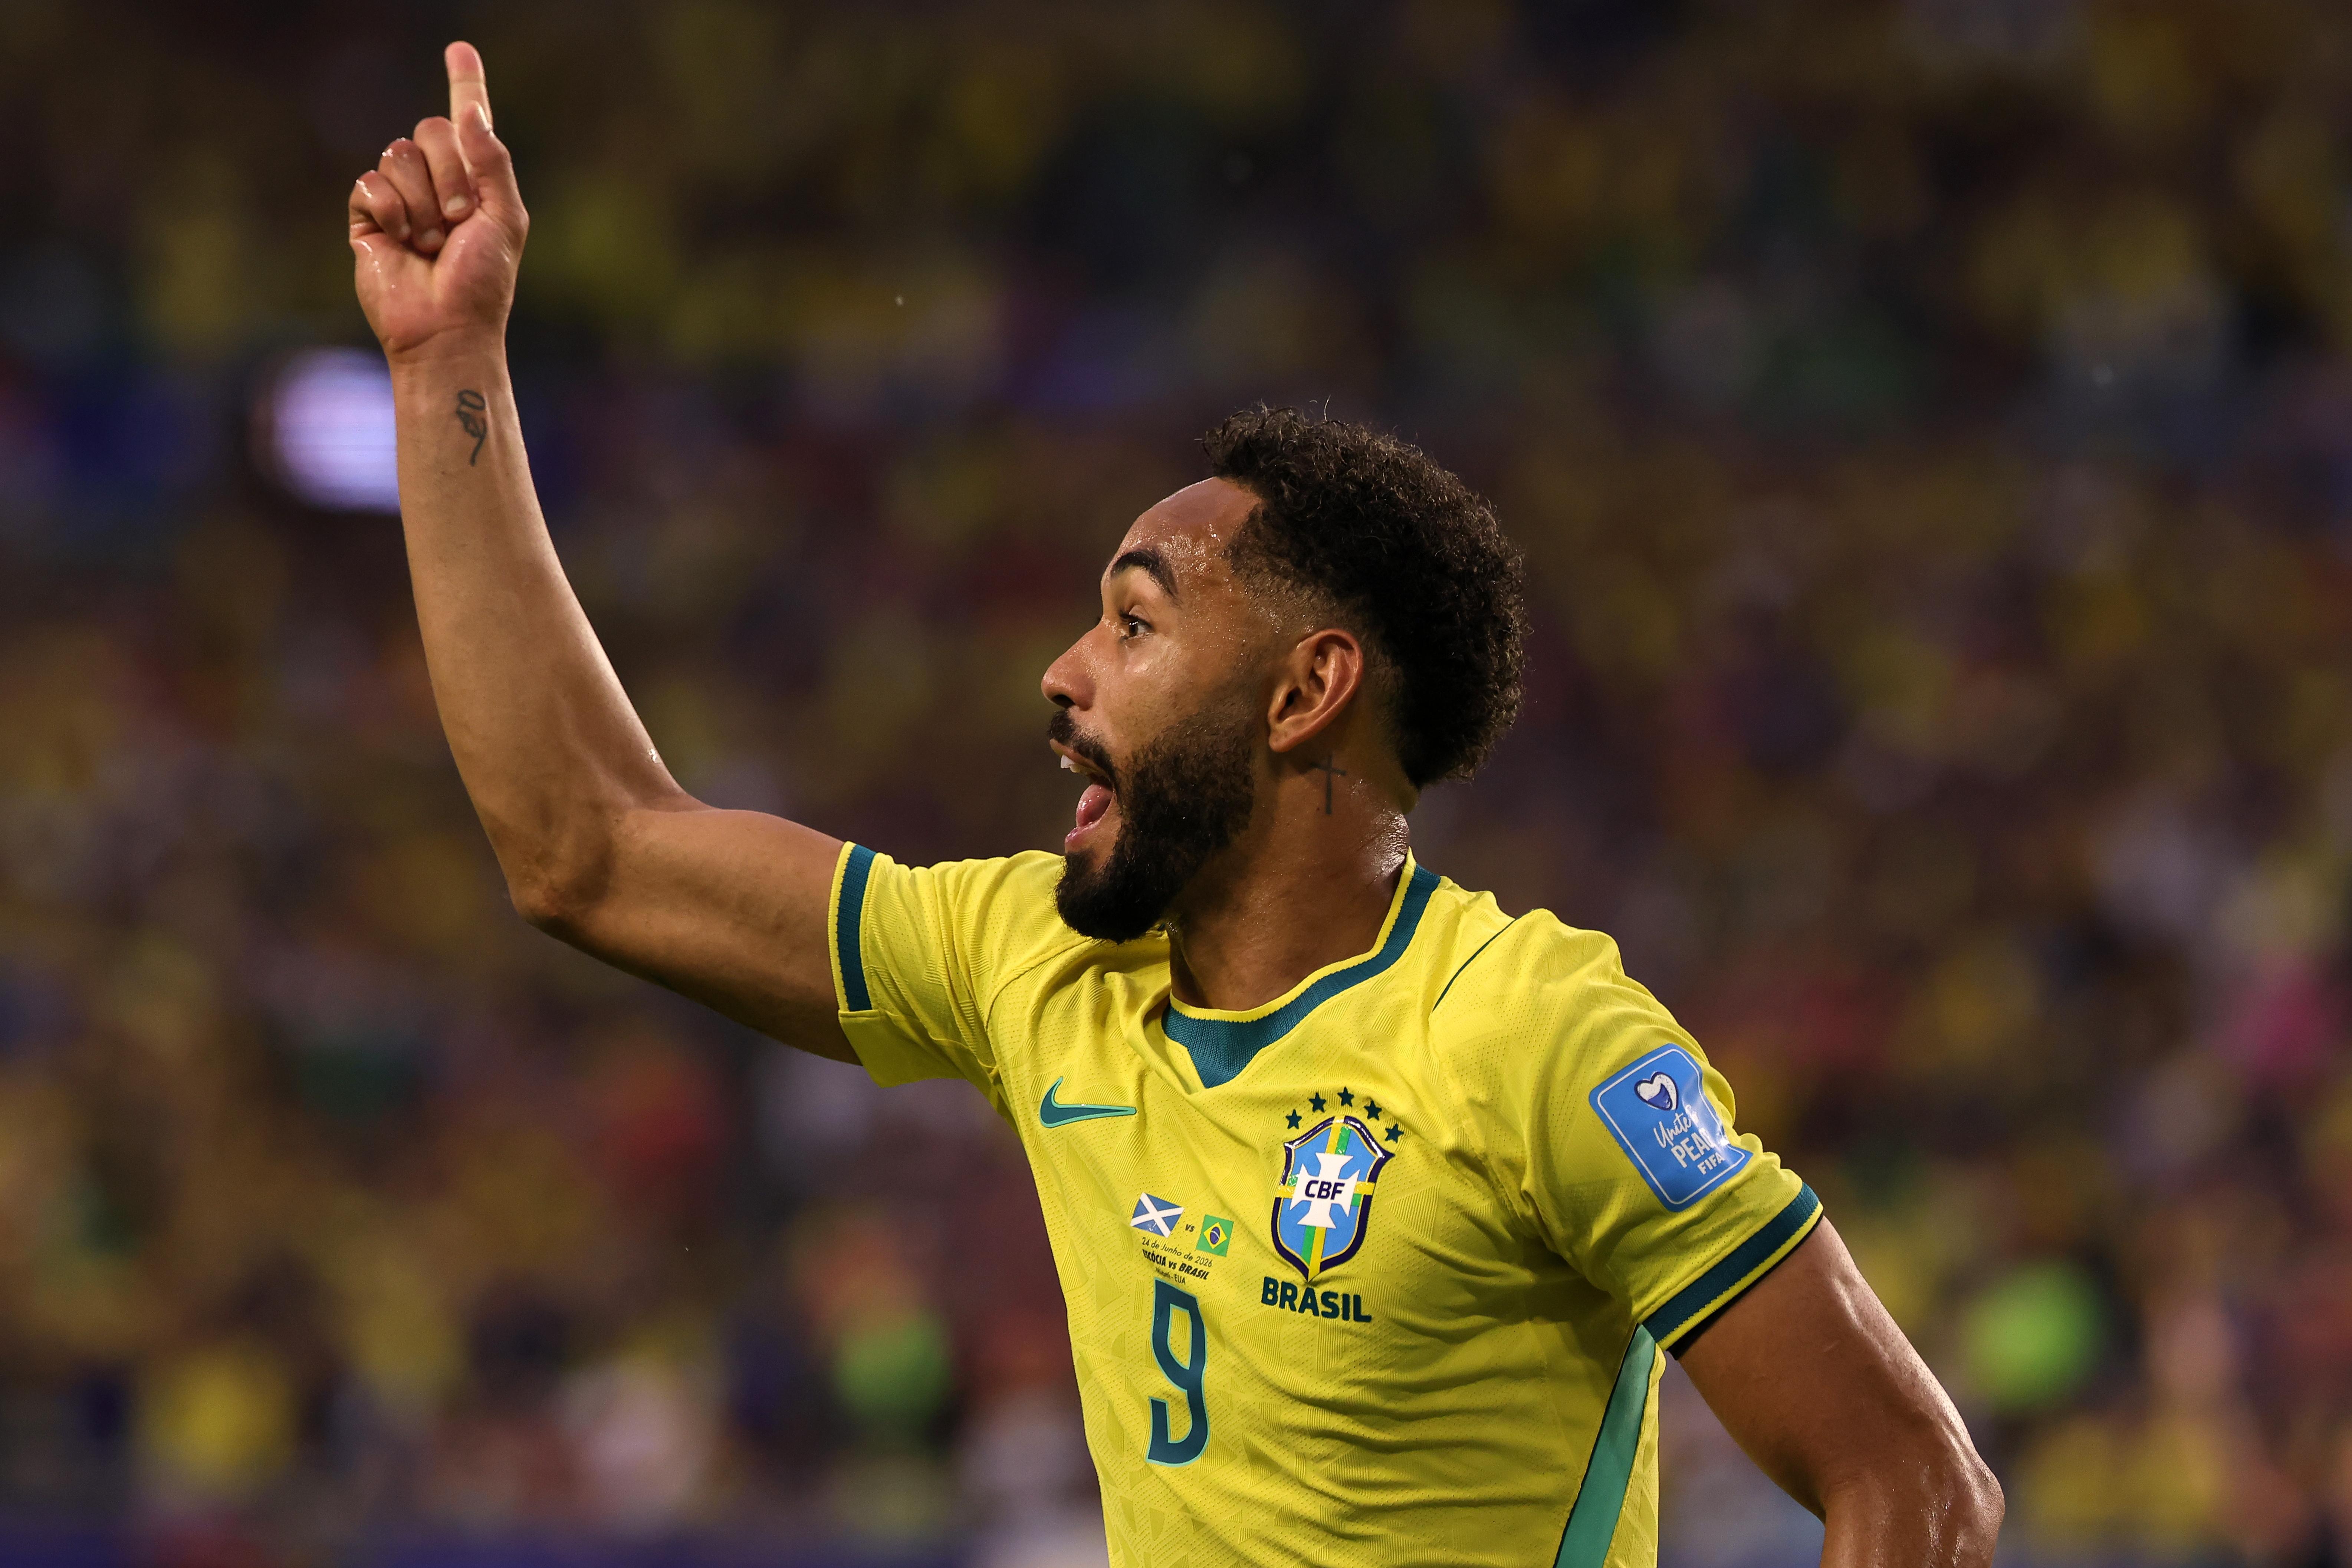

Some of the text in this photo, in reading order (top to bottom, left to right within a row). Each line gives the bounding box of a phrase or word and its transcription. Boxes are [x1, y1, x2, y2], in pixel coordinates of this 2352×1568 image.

[1653, 1113, 1692, 1148] Unite
[1671, 1128, 1716, 1168] PEAC
[1697, 1152, 1725, 1175] FIFA
[1304, 1180, 1346, 1200] CBF
[1142, 1237, 1150, 1246] 24
[1161, 1243, 1182, 1256] Junho
[1183, 1253, 1193, 1261] de
[1195, 1256, 1213, 1268] 2026
[1174, 1274, 1186, 1285] EUA
[1178, 1262, 1209, 1279] BRASIL
[1261, 1276, 1372, 1322] BRASIL
[1146, 1277, 1210, 1467] 9
